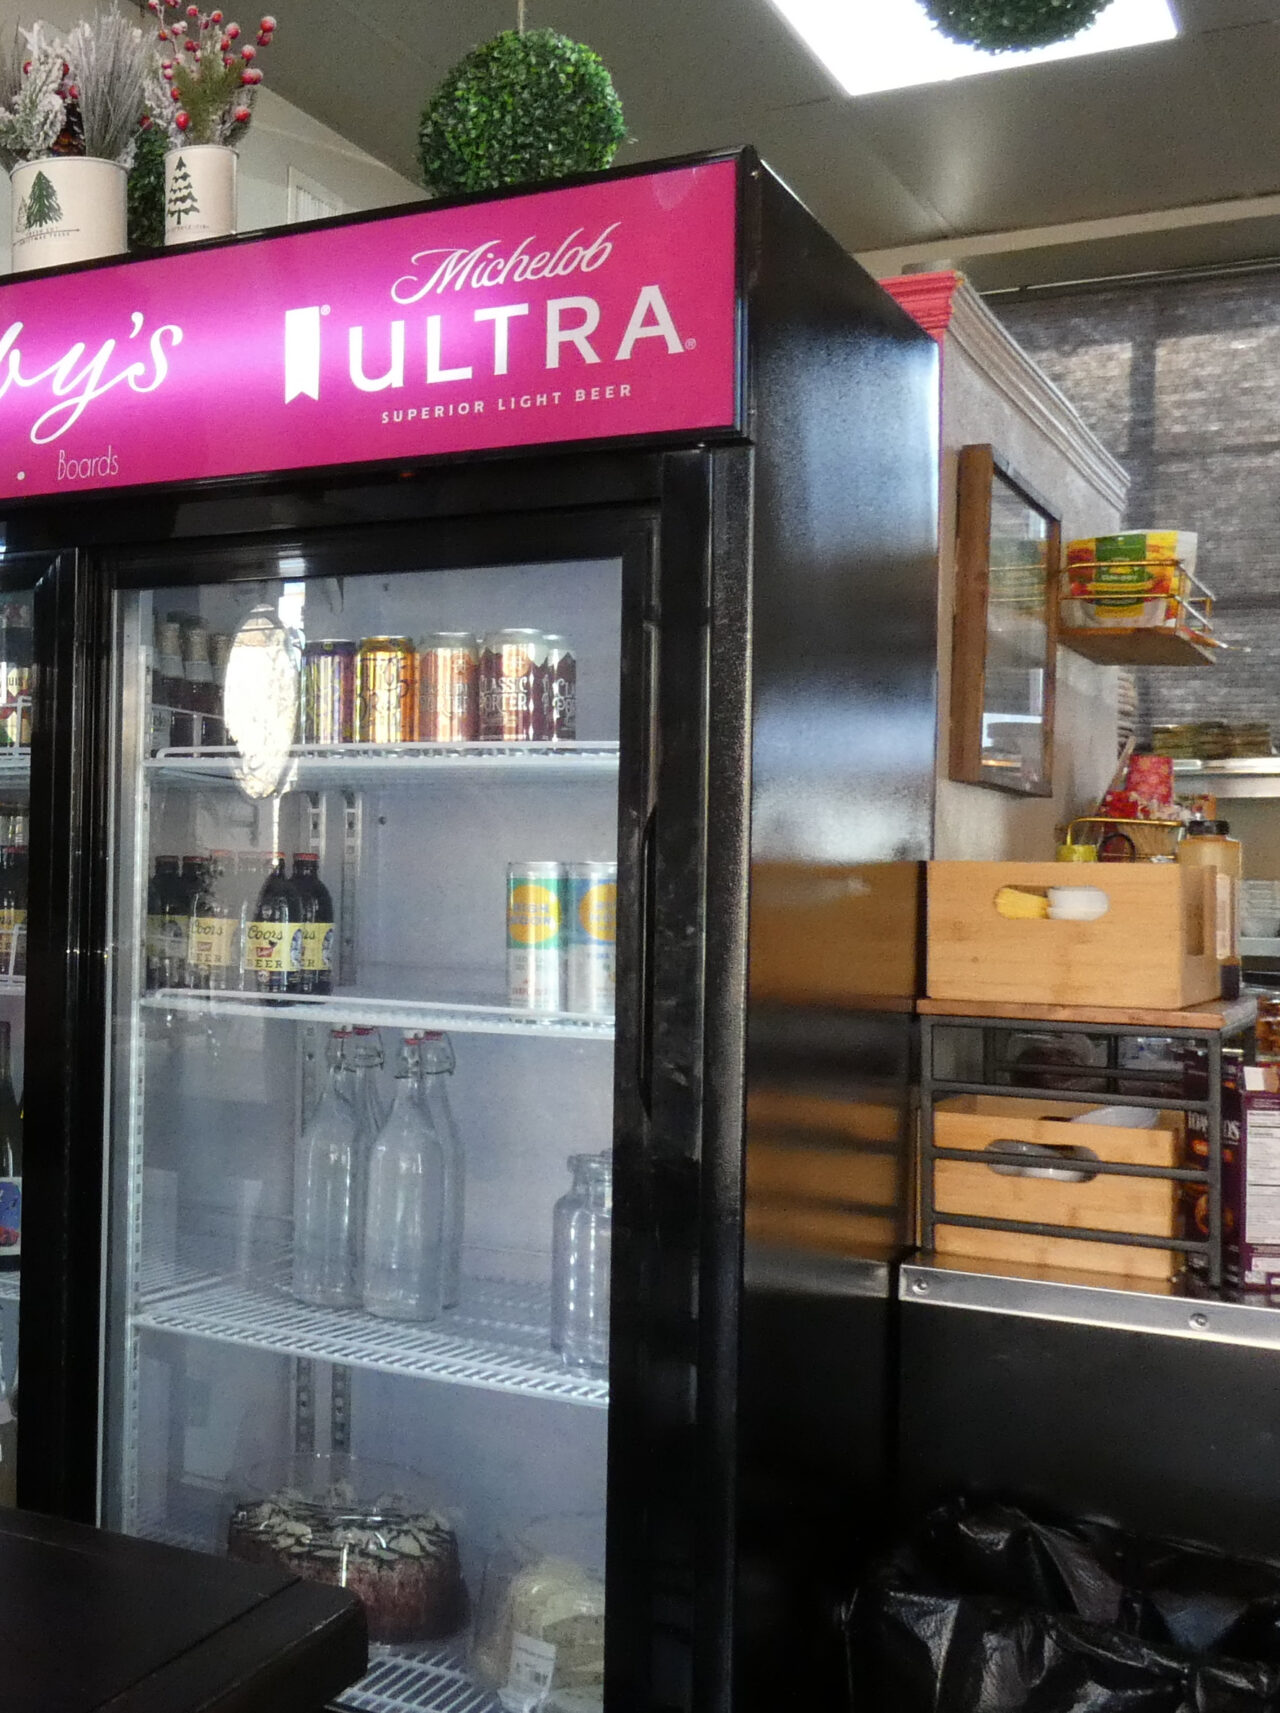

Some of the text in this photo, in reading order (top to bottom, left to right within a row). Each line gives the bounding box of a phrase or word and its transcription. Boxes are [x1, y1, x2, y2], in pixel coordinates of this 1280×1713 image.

[390, 221, 622, 305] Michelob
[349, 285, 684, 393] ULTRA
[382, 383, 632, 424] SUPERIOR LIGHT BEER
[56, 446, 120, 482] Boards
[247, 926, 283, 941] Coors
